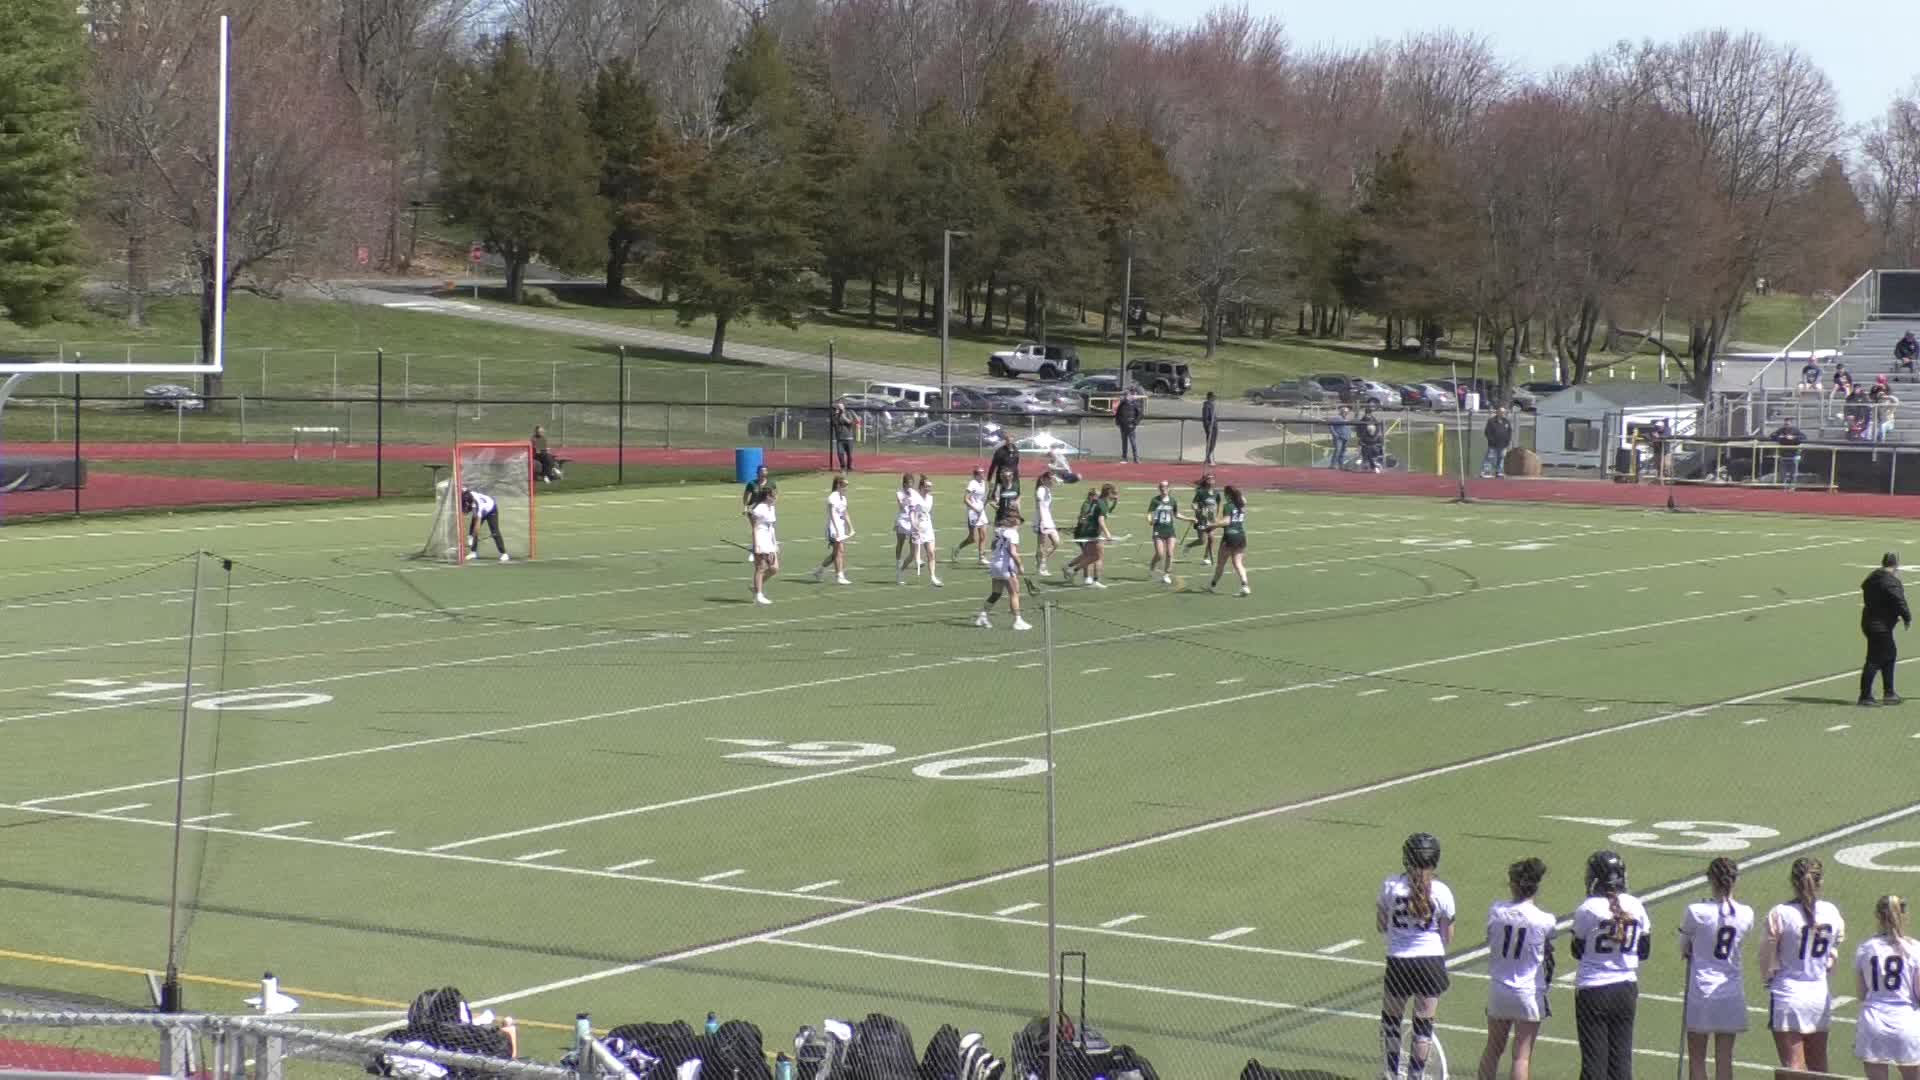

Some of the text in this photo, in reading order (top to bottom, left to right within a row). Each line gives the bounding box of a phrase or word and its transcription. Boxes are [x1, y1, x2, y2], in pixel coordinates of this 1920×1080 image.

[1392, 896, 1436, 930] 2
[1502, 915, 1527, 960] 11
[1594, 918, 1639, 954] 20
[1714, 925, 1737, 960] 8
[1799, 923, 1832, 960] 16
[1870, 955, 1903, 991] 18
